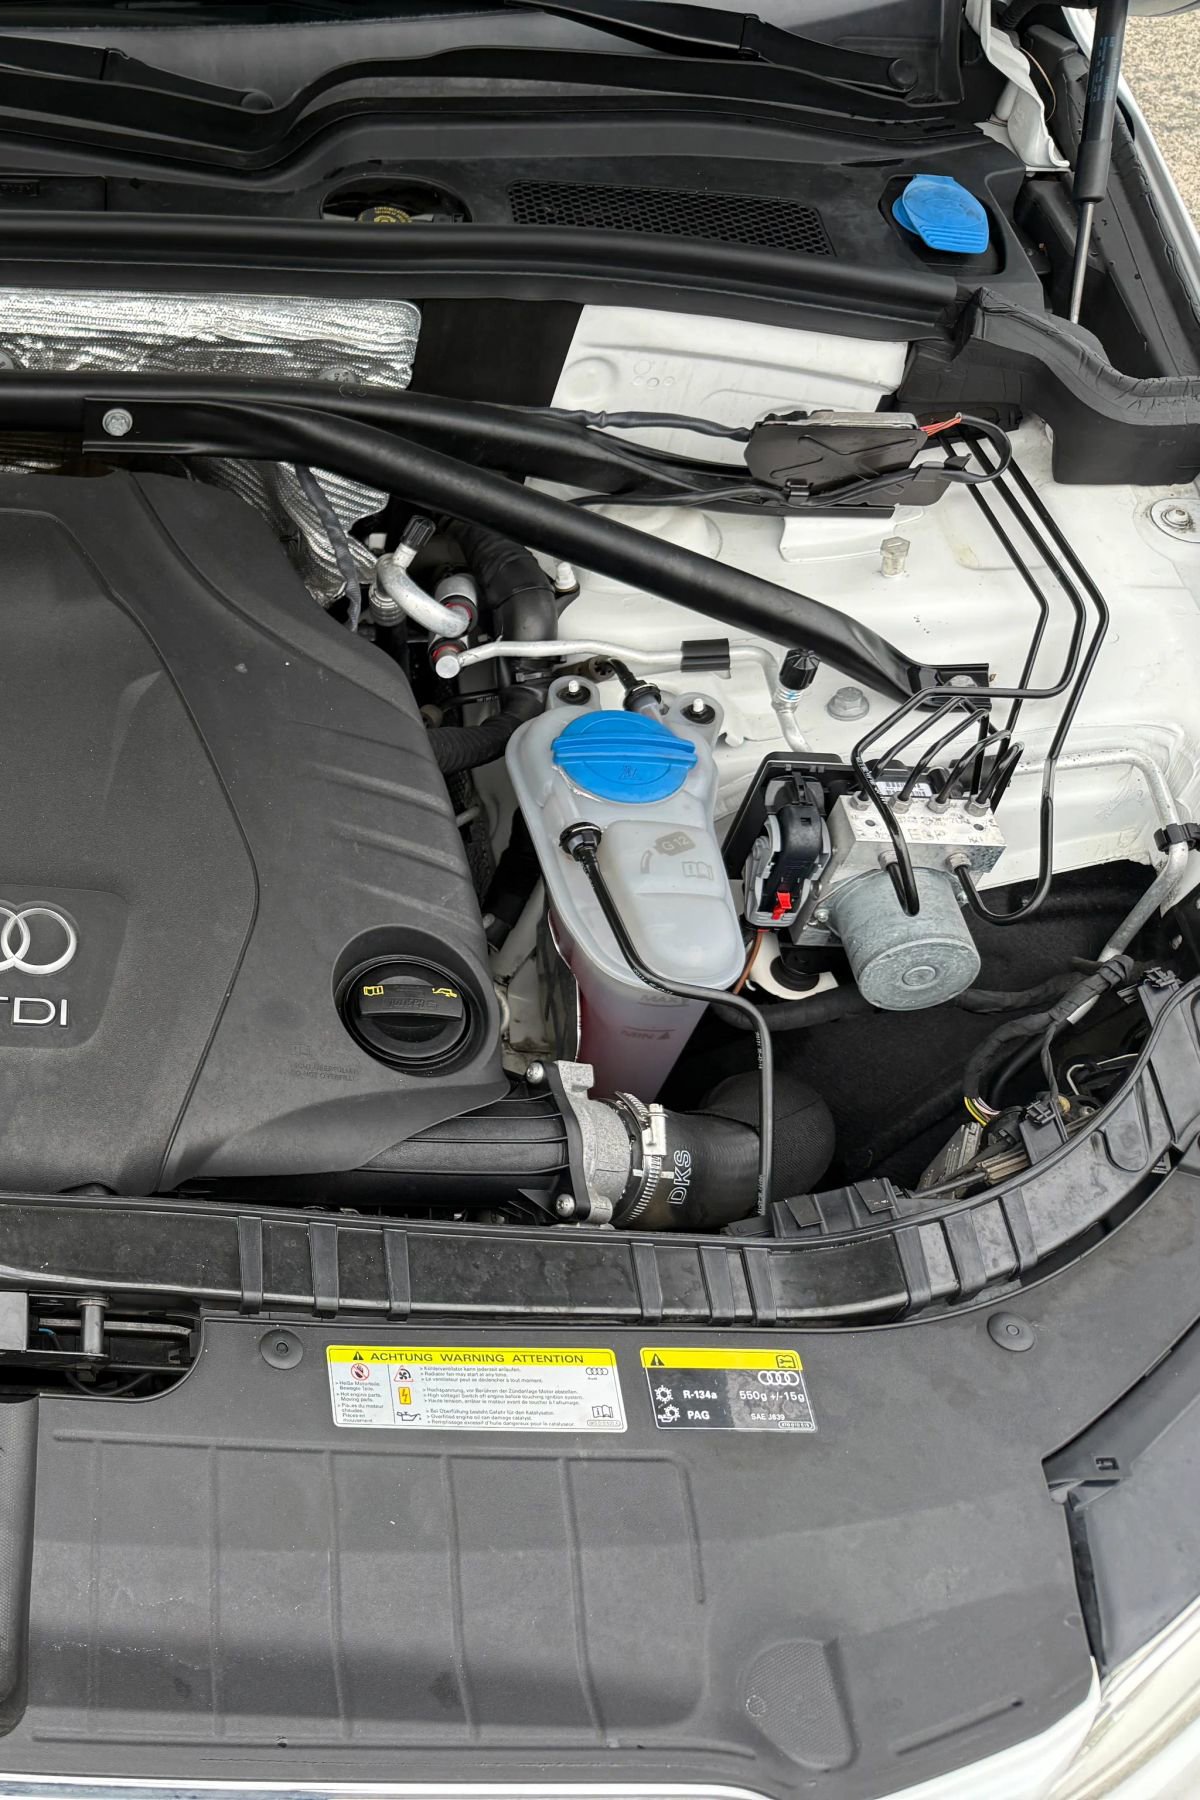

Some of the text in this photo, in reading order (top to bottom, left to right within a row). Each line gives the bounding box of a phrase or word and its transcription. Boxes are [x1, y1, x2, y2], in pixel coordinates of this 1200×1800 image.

[666, 1150, 692, 1205] DKS
[370, 1352, 584, 1364] ACHTUNG WARNING ATTENTION
[682, 1390, 718, 1399] R-134a
[738, 1390, 768, 1400] 550g
[686, 1410, 710, 1419] PAG
